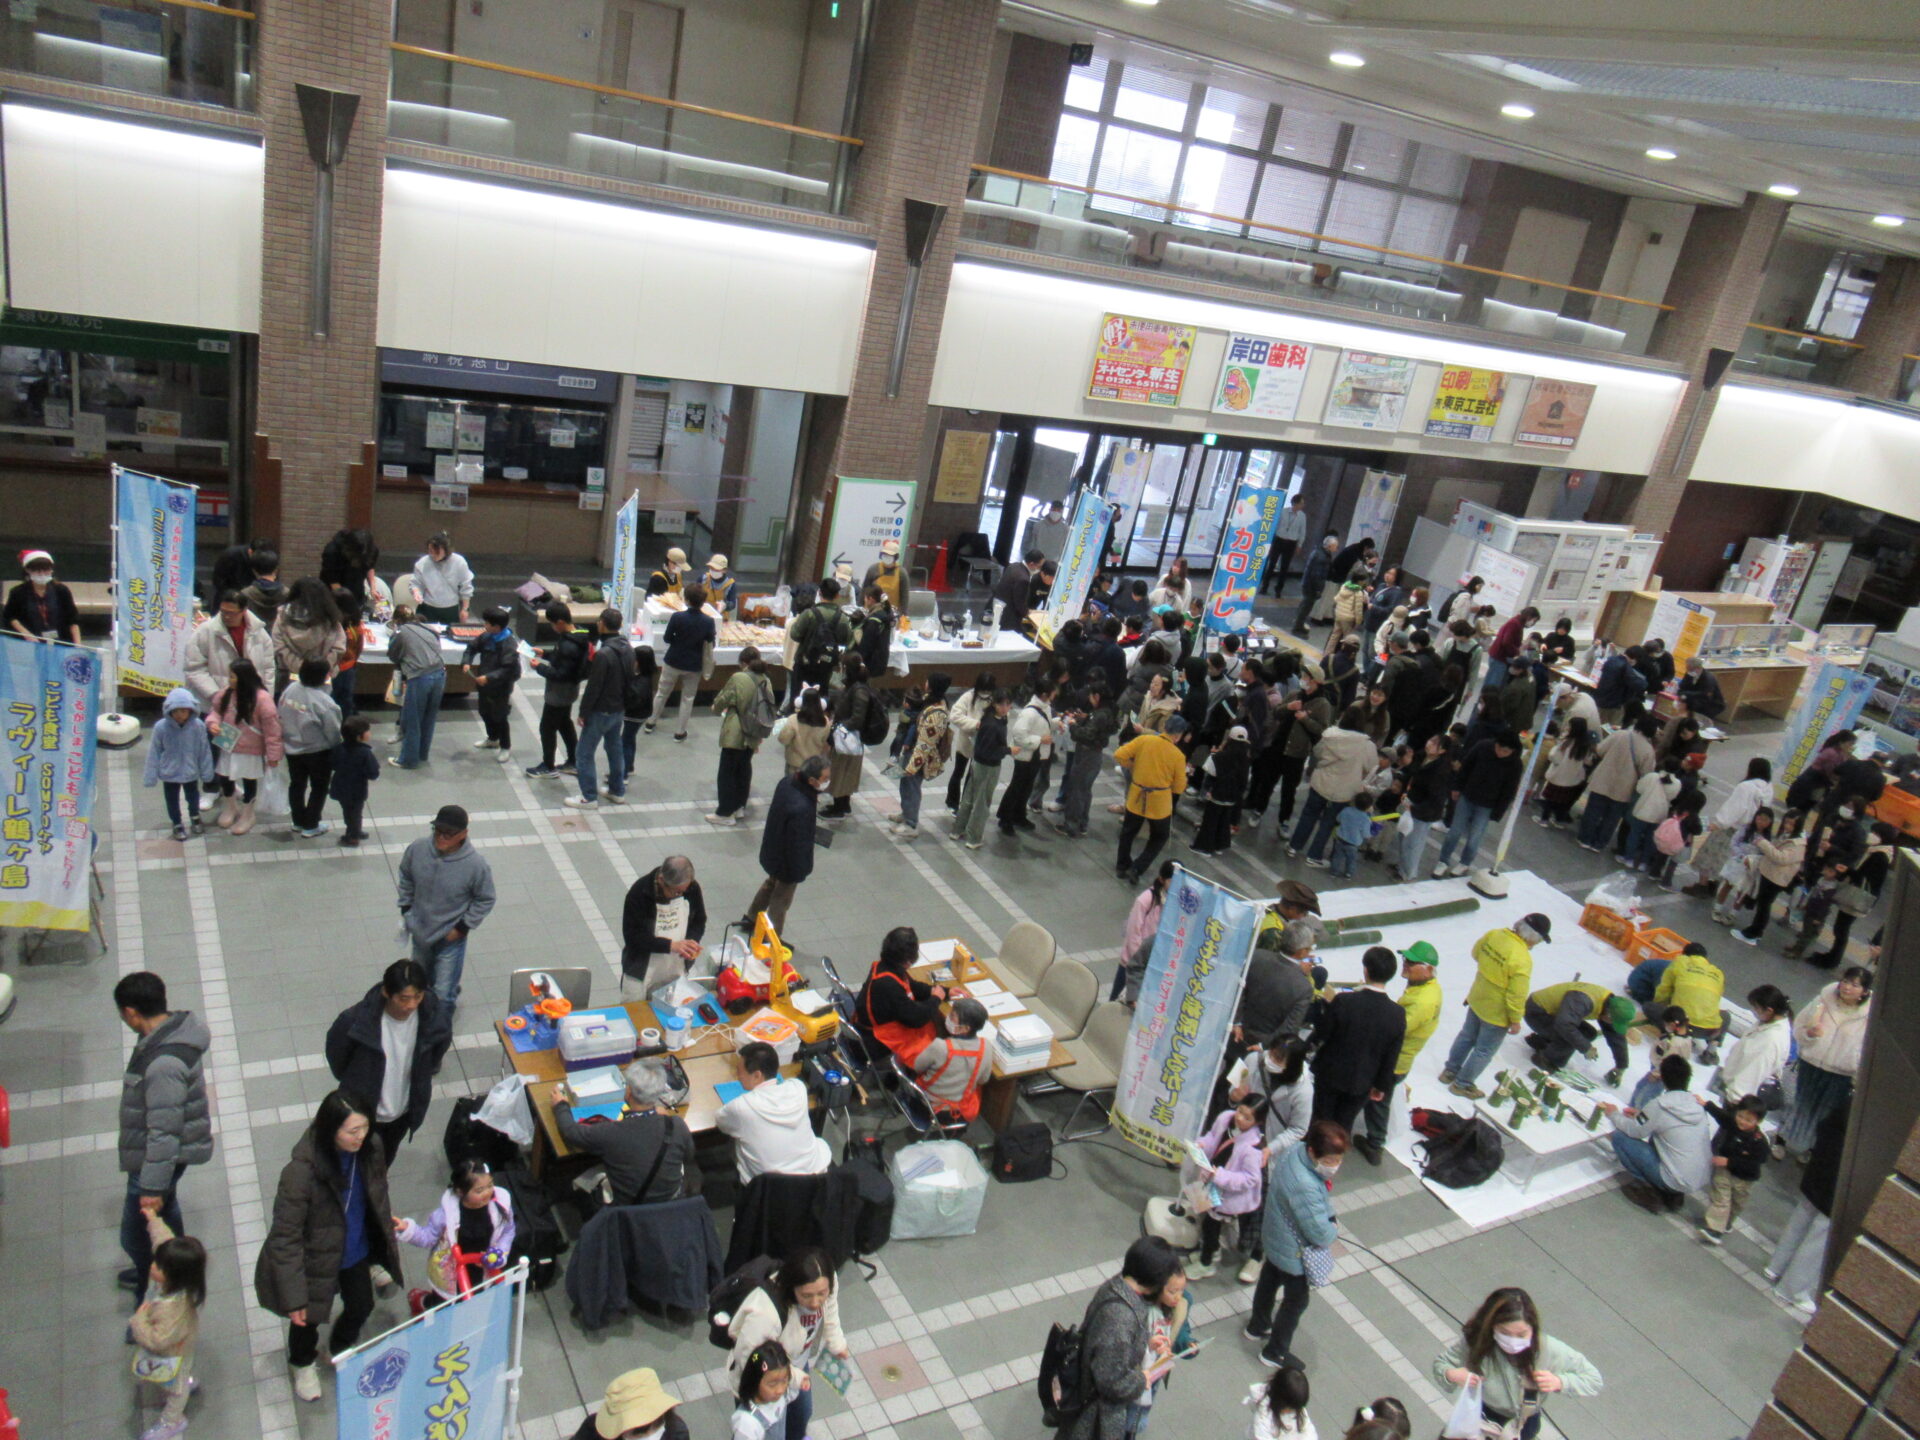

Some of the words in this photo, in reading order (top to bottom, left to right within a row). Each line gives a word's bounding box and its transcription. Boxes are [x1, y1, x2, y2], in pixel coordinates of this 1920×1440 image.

[1228, 337, 1307, 370] 岸田歯科
[1440, 370, 1473, 391] 印刷
[150, 507, 166, 632] コミュニティーハウス
[1212, 527, 1255, 618] カローレ
[1247, 495, 1279, 582] 認定NPO法人
[41, 681, 61, 751] こども食堂
[0, 701, 36, 889] ラヴィーレ鶴ヶ島
